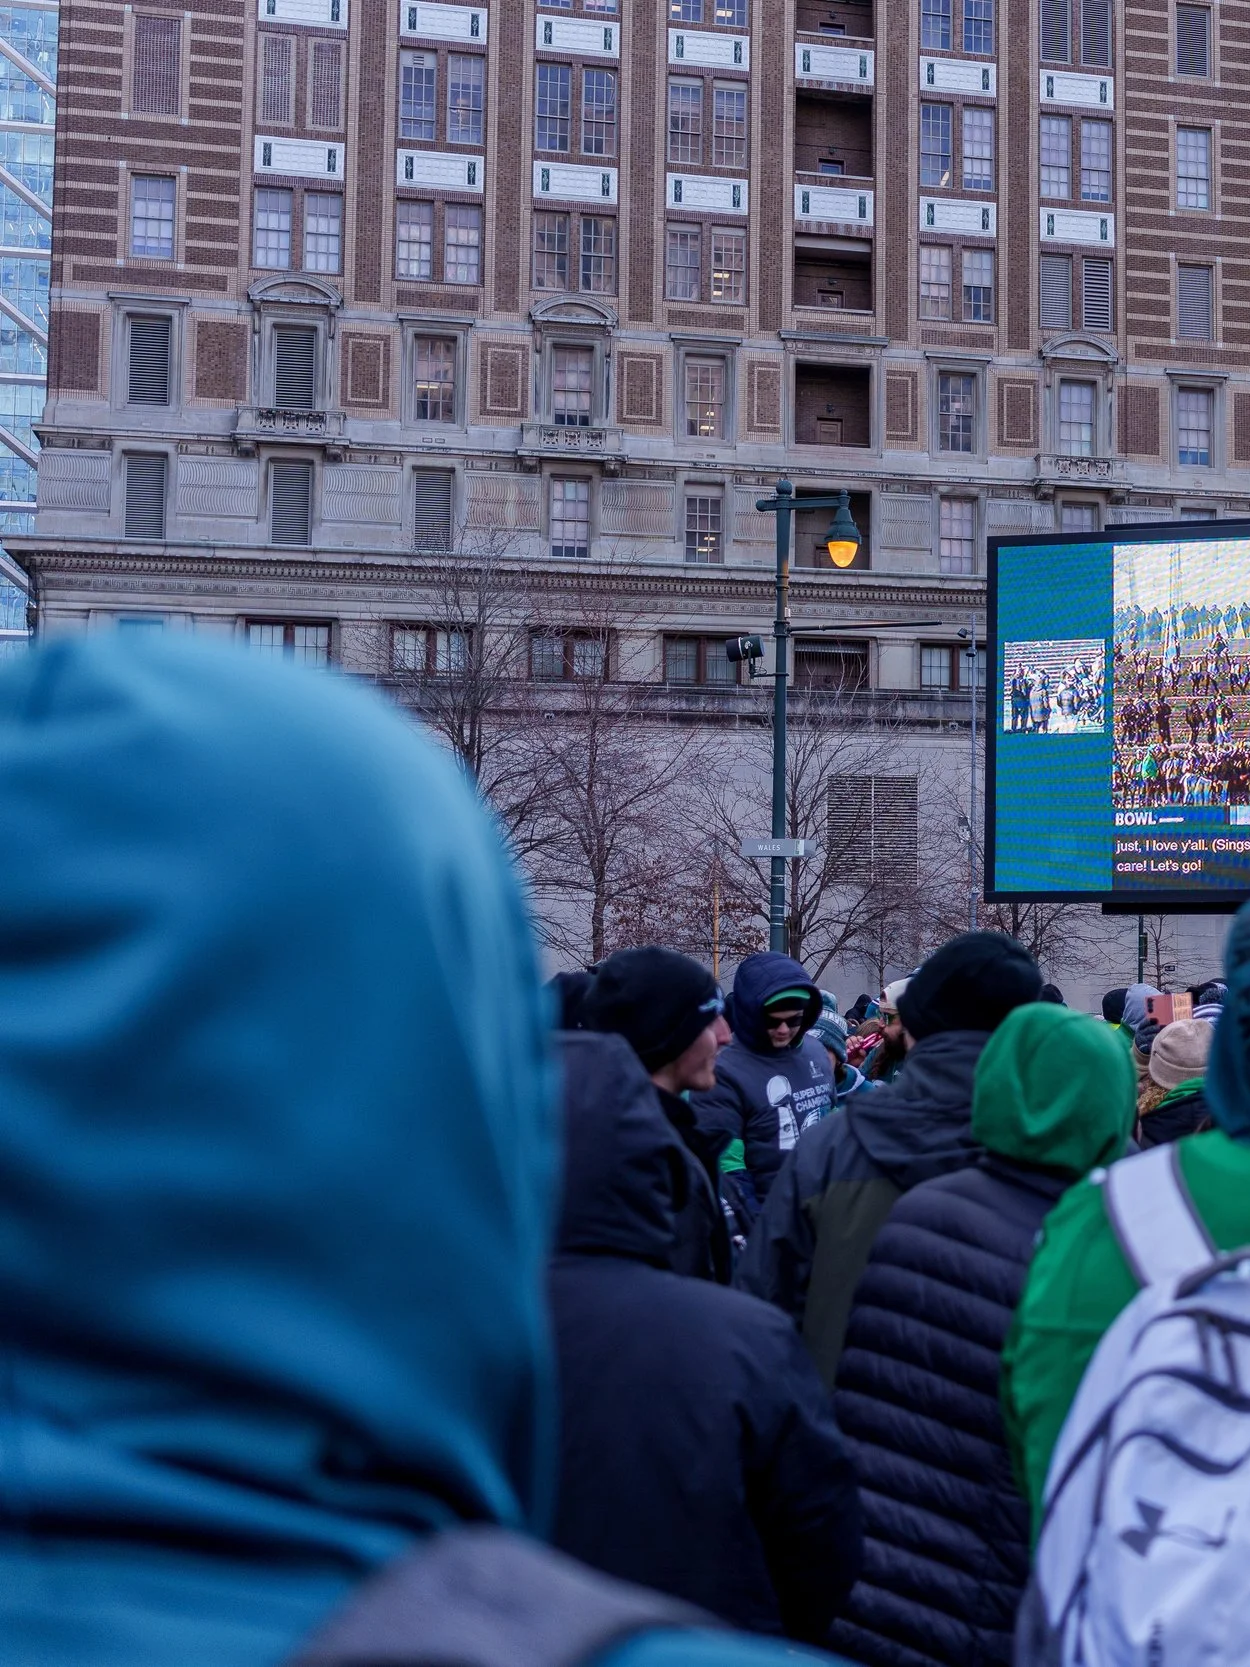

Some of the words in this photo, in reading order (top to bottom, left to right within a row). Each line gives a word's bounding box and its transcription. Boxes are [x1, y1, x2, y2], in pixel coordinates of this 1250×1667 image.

[1115, 811, 1157, 826] BOWL
[1116, 840, 1142, 854] just,
[1145, 840, 1150, 851] I
[1153, 840, 1178, 851] love
[1182, 839, 1209, 853] y'all.
[1116, 860, 1147, 872] care!
[1151, 860, 1179, 872] Let's
[1182, 860, 1202, 873] go!
[792, 1087, 816, 1102] SUPER
